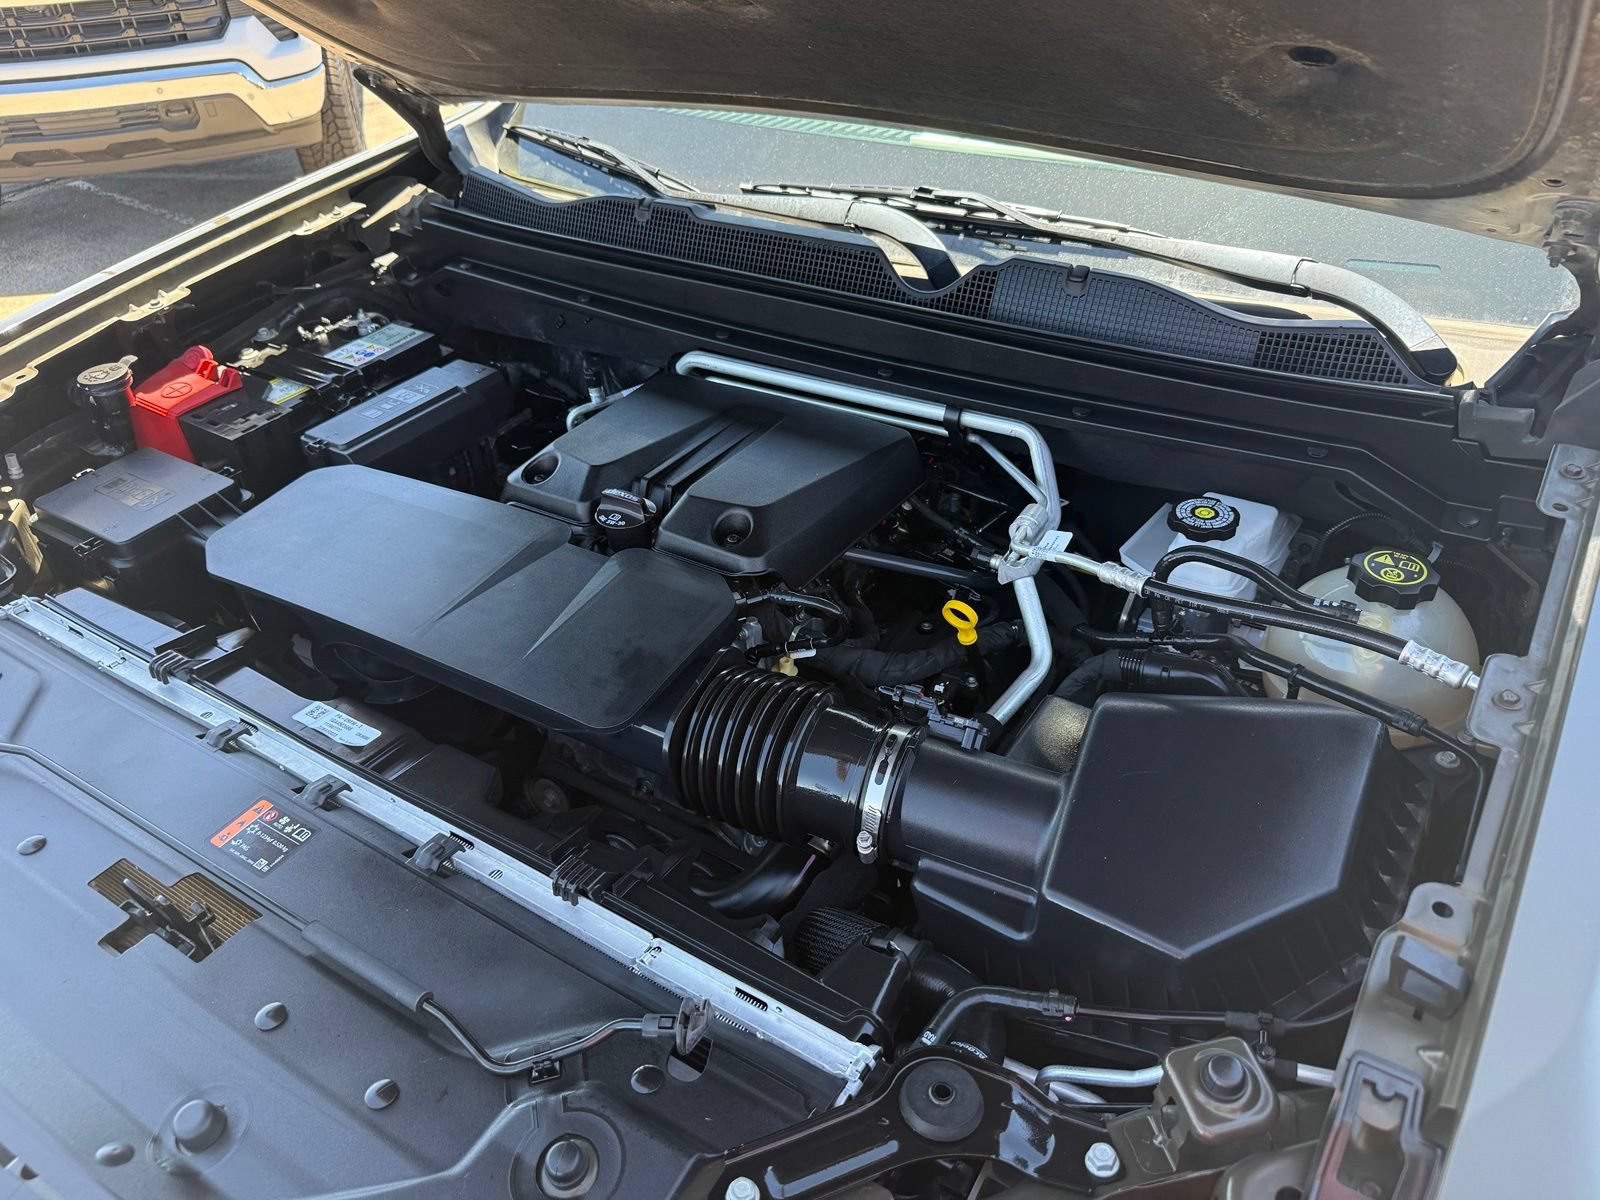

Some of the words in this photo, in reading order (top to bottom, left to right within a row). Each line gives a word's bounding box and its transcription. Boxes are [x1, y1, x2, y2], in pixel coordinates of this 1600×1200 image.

[607, 488, 640, 501] dexos
[923, 1031, 937, 1042] RAD
[950, 1041, 988, 1059] ACDelco
